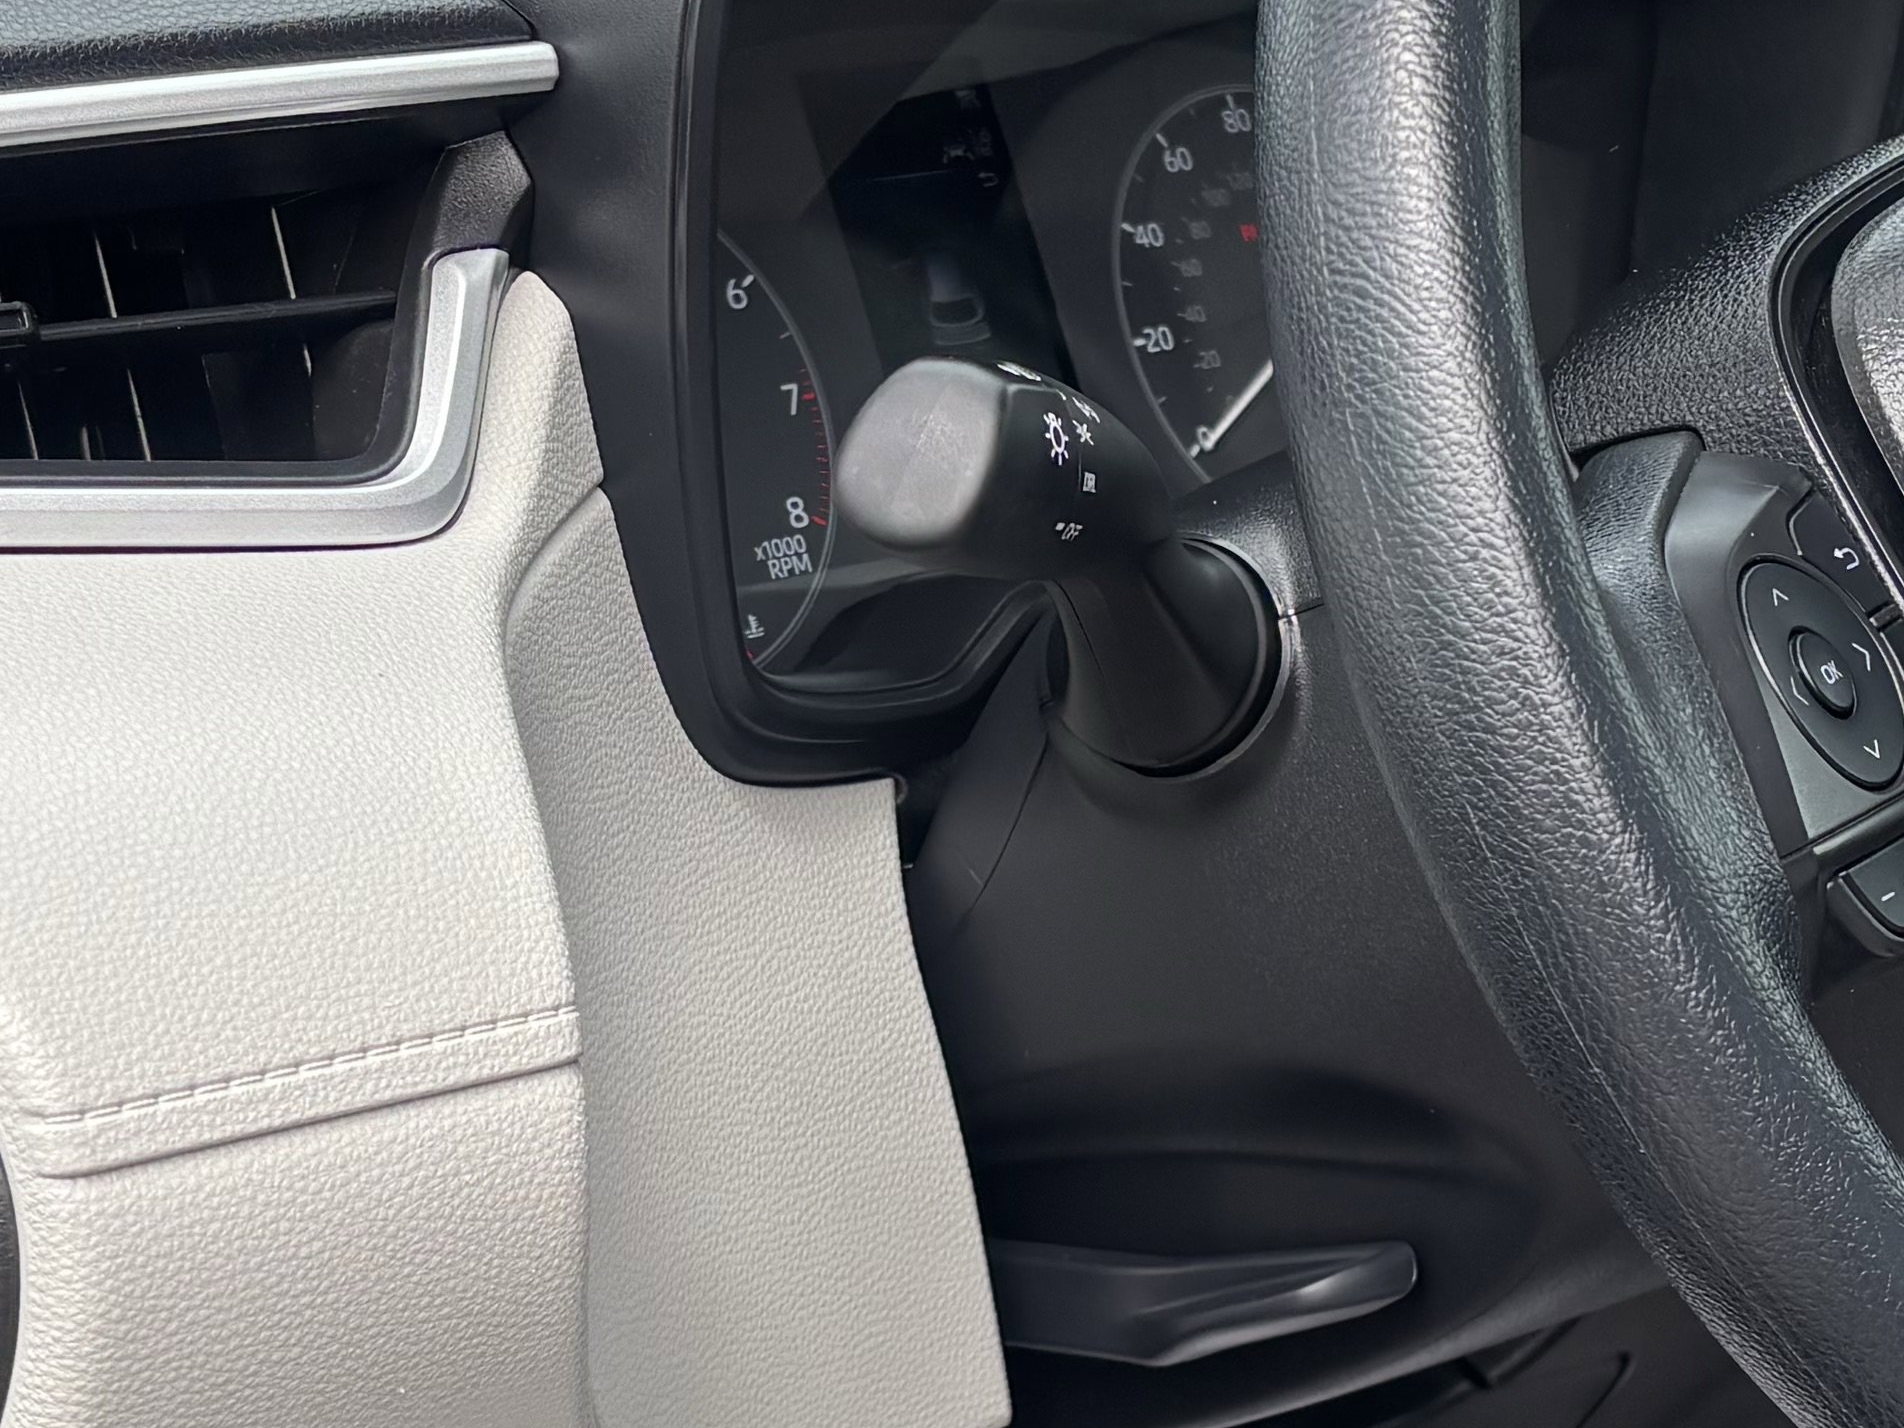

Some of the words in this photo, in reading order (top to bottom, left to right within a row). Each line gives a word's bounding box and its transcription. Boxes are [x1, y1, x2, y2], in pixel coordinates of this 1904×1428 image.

[1221, 109, 1252, 133] 80
[1163, 147, 1194, 172] 60
[1133, 223, 1164, 247] 40
[726, 278, 747, 310] 6
[1143, 326, 1174, 353] 20
[780, 383, 798, 416] 7
[786, 497, 809, 529] 8
[754, 535, 807, 561] x1000
[768, 554, 813, 580] RPM
[1820, 659, 1843, 684] OK
